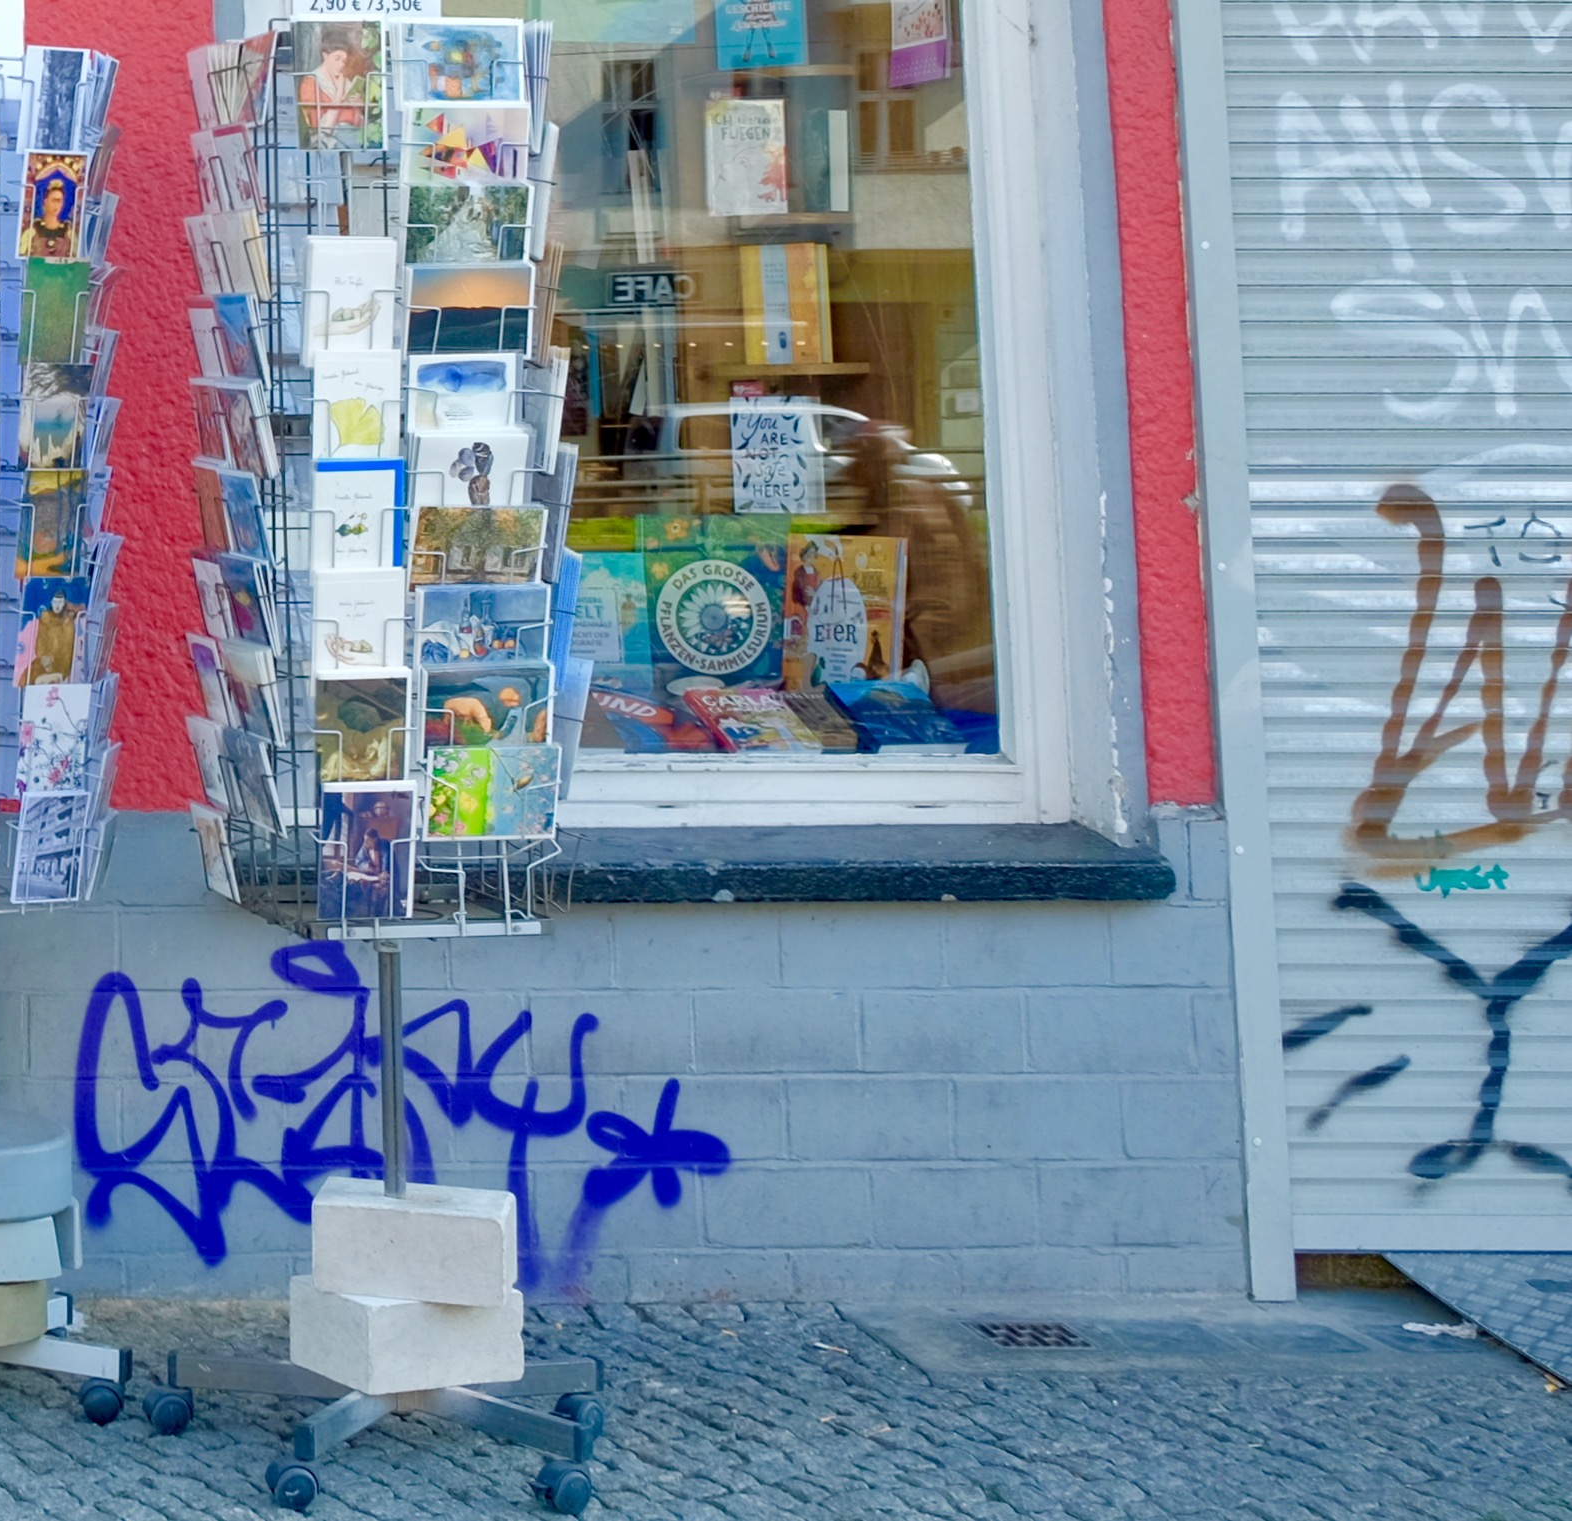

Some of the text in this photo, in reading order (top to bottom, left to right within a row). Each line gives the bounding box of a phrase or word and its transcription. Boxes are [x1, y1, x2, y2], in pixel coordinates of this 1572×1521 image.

[721, 127, 771, 141] FLIEGEN
[741, 411, 779, 442] You
[760, 432, 789, 446] ARE
[752, 483, 791, 498] HERE
[672, 564, 755, 592] DAS GROSSE
[661, 600, 767, 673] PFLANZEN-SAMMELSURIUM
